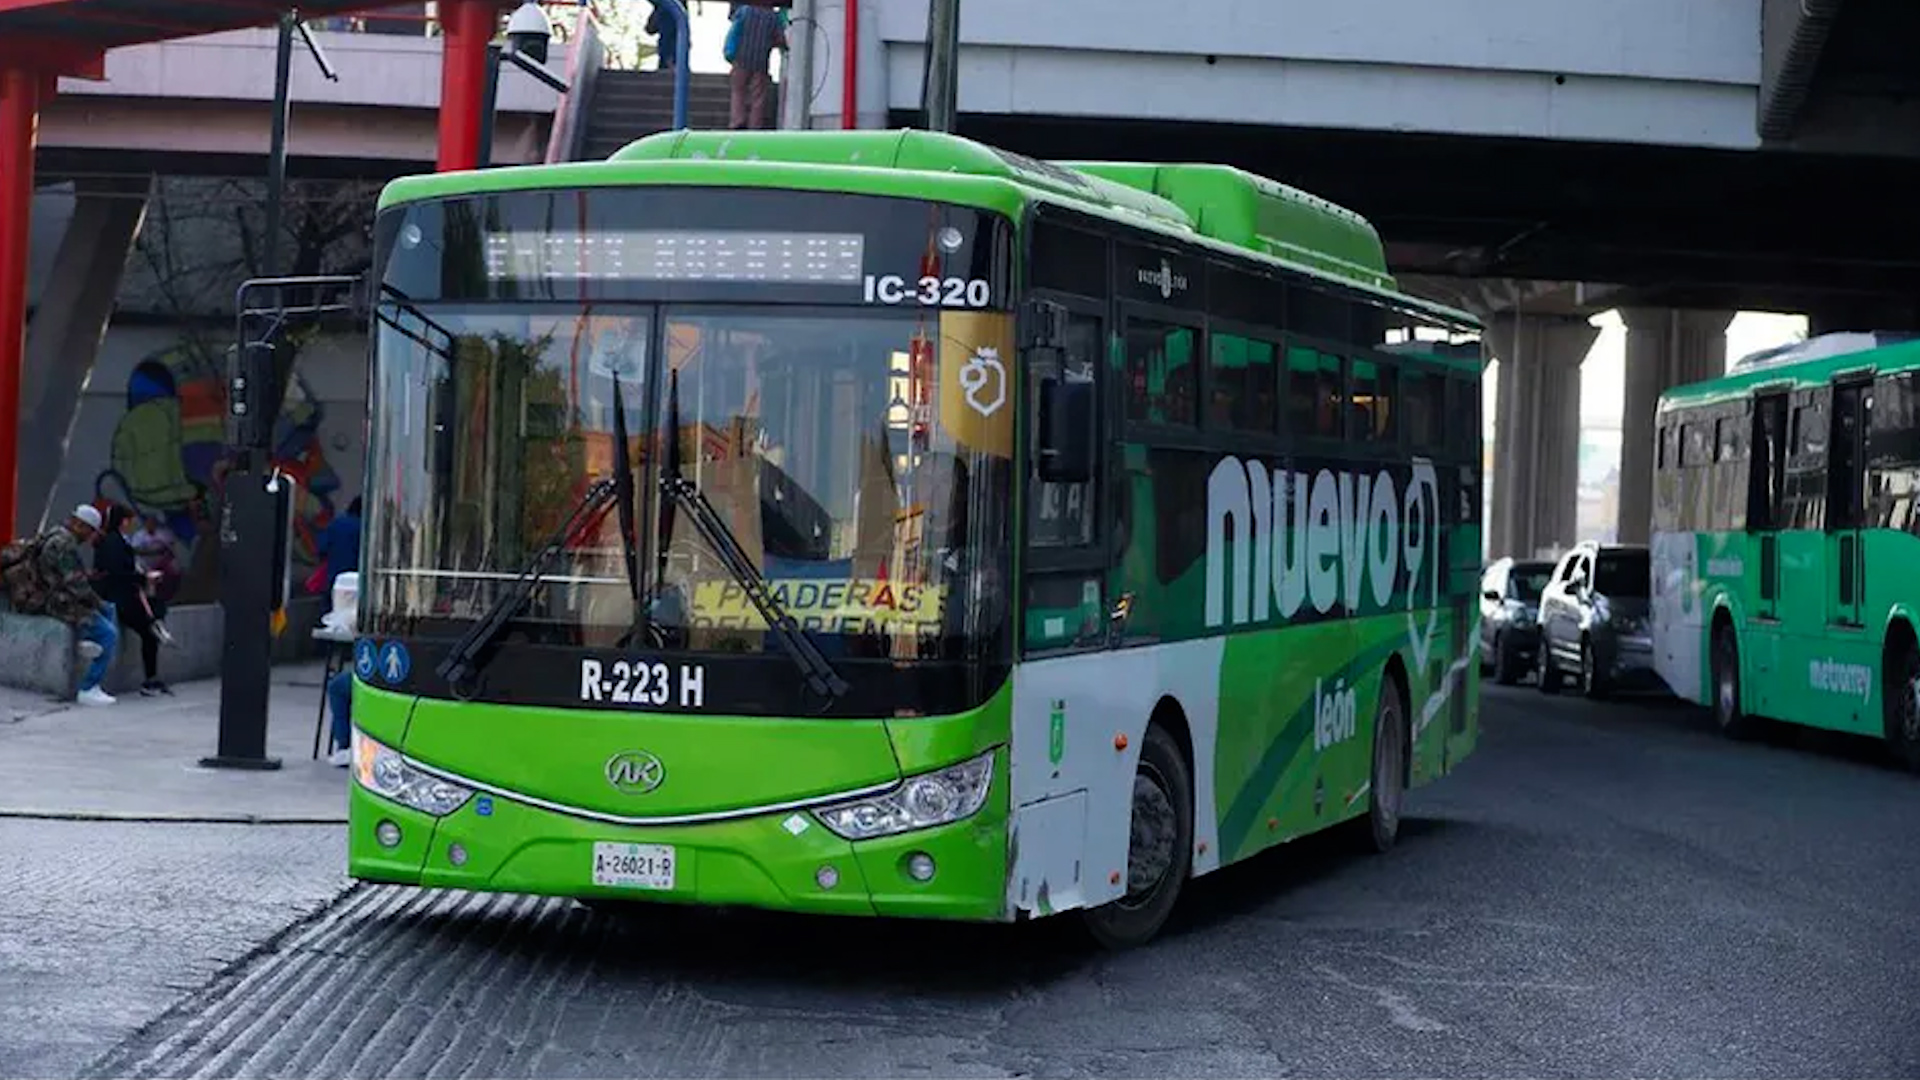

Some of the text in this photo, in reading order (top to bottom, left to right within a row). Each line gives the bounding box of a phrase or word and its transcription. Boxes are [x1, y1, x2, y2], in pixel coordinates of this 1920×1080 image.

[863, 275, 990, 308] IC-320
[581, 659, 704, 707] R-223 H
[1314, 676, 1355, 751] león
[596, 854, 671, 878] A-26021-R
